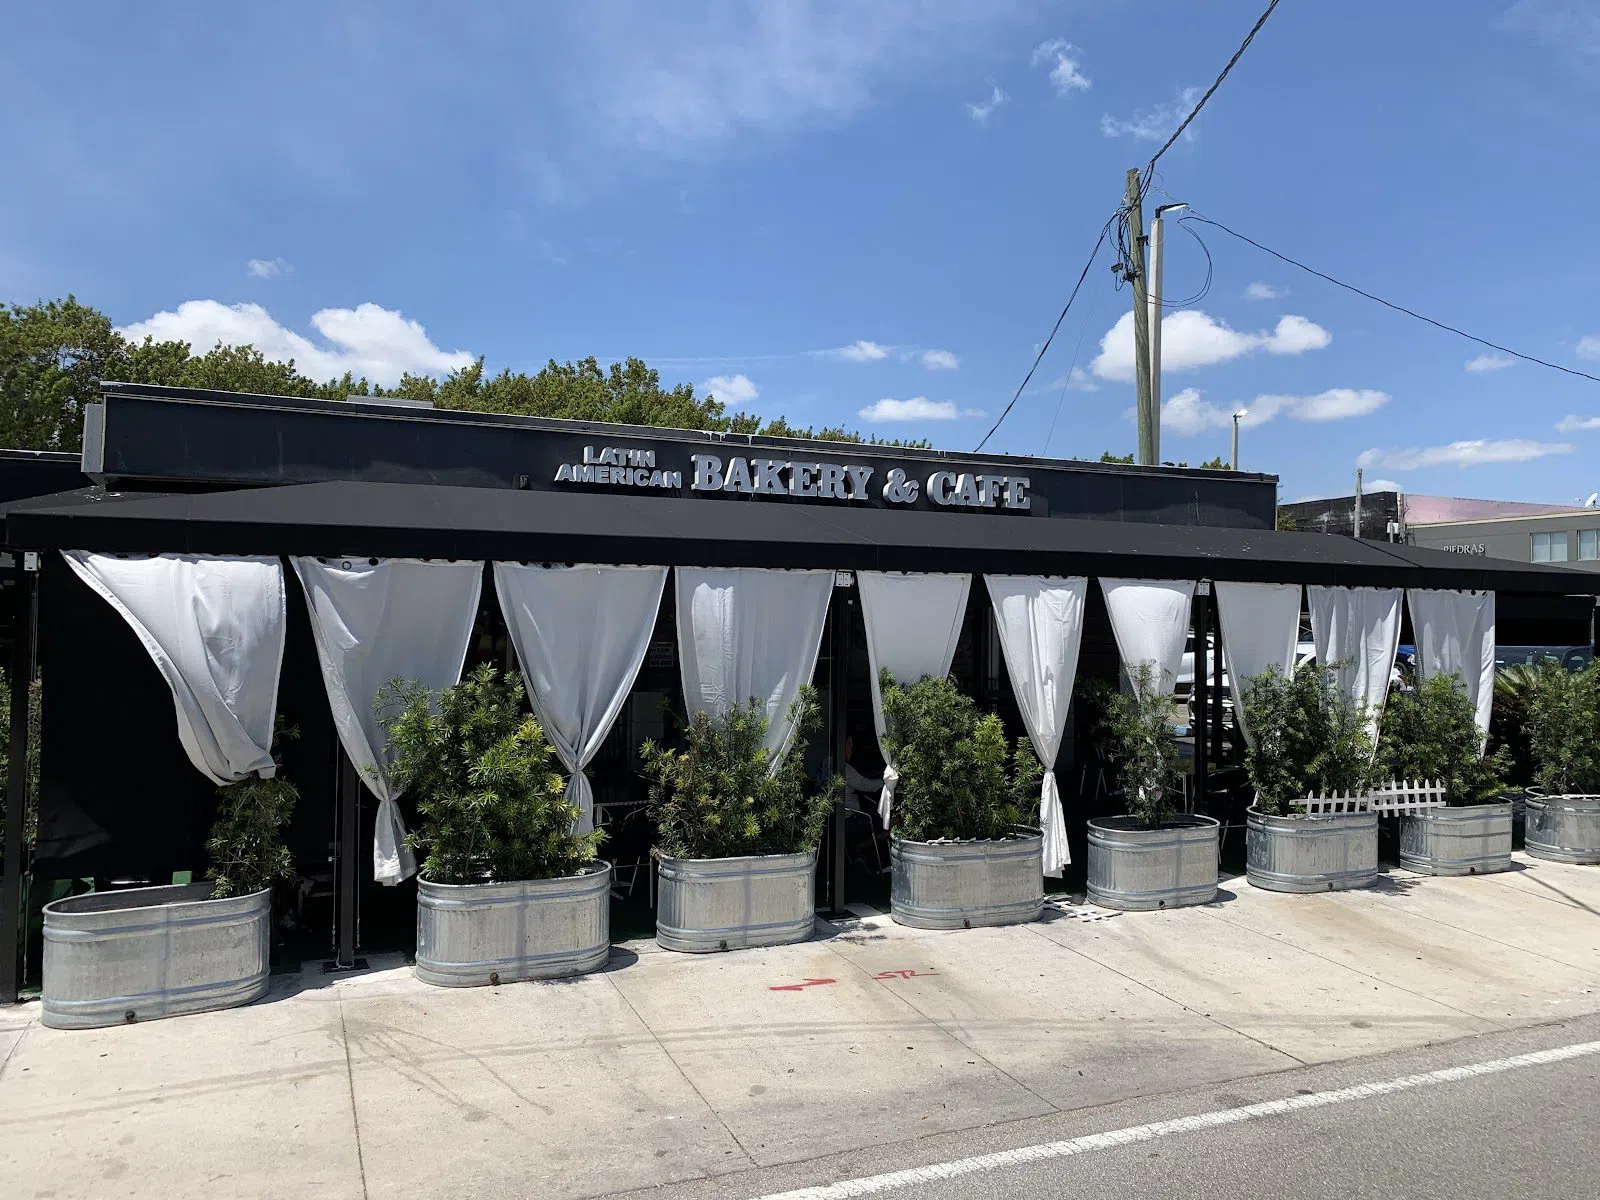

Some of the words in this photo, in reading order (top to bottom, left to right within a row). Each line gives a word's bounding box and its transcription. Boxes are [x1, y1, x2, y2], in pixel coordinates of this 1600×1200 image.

[583, 446, 656, 468] LATIN
[554, 464, 682, 489] AMERICAN
[690, 453, 874, 500] BAKERY
[883, 467, 920, 504] &
[926, 470, 1031, 510] CAFE
[1443, 543, 1485, 554] PIEDRAS
